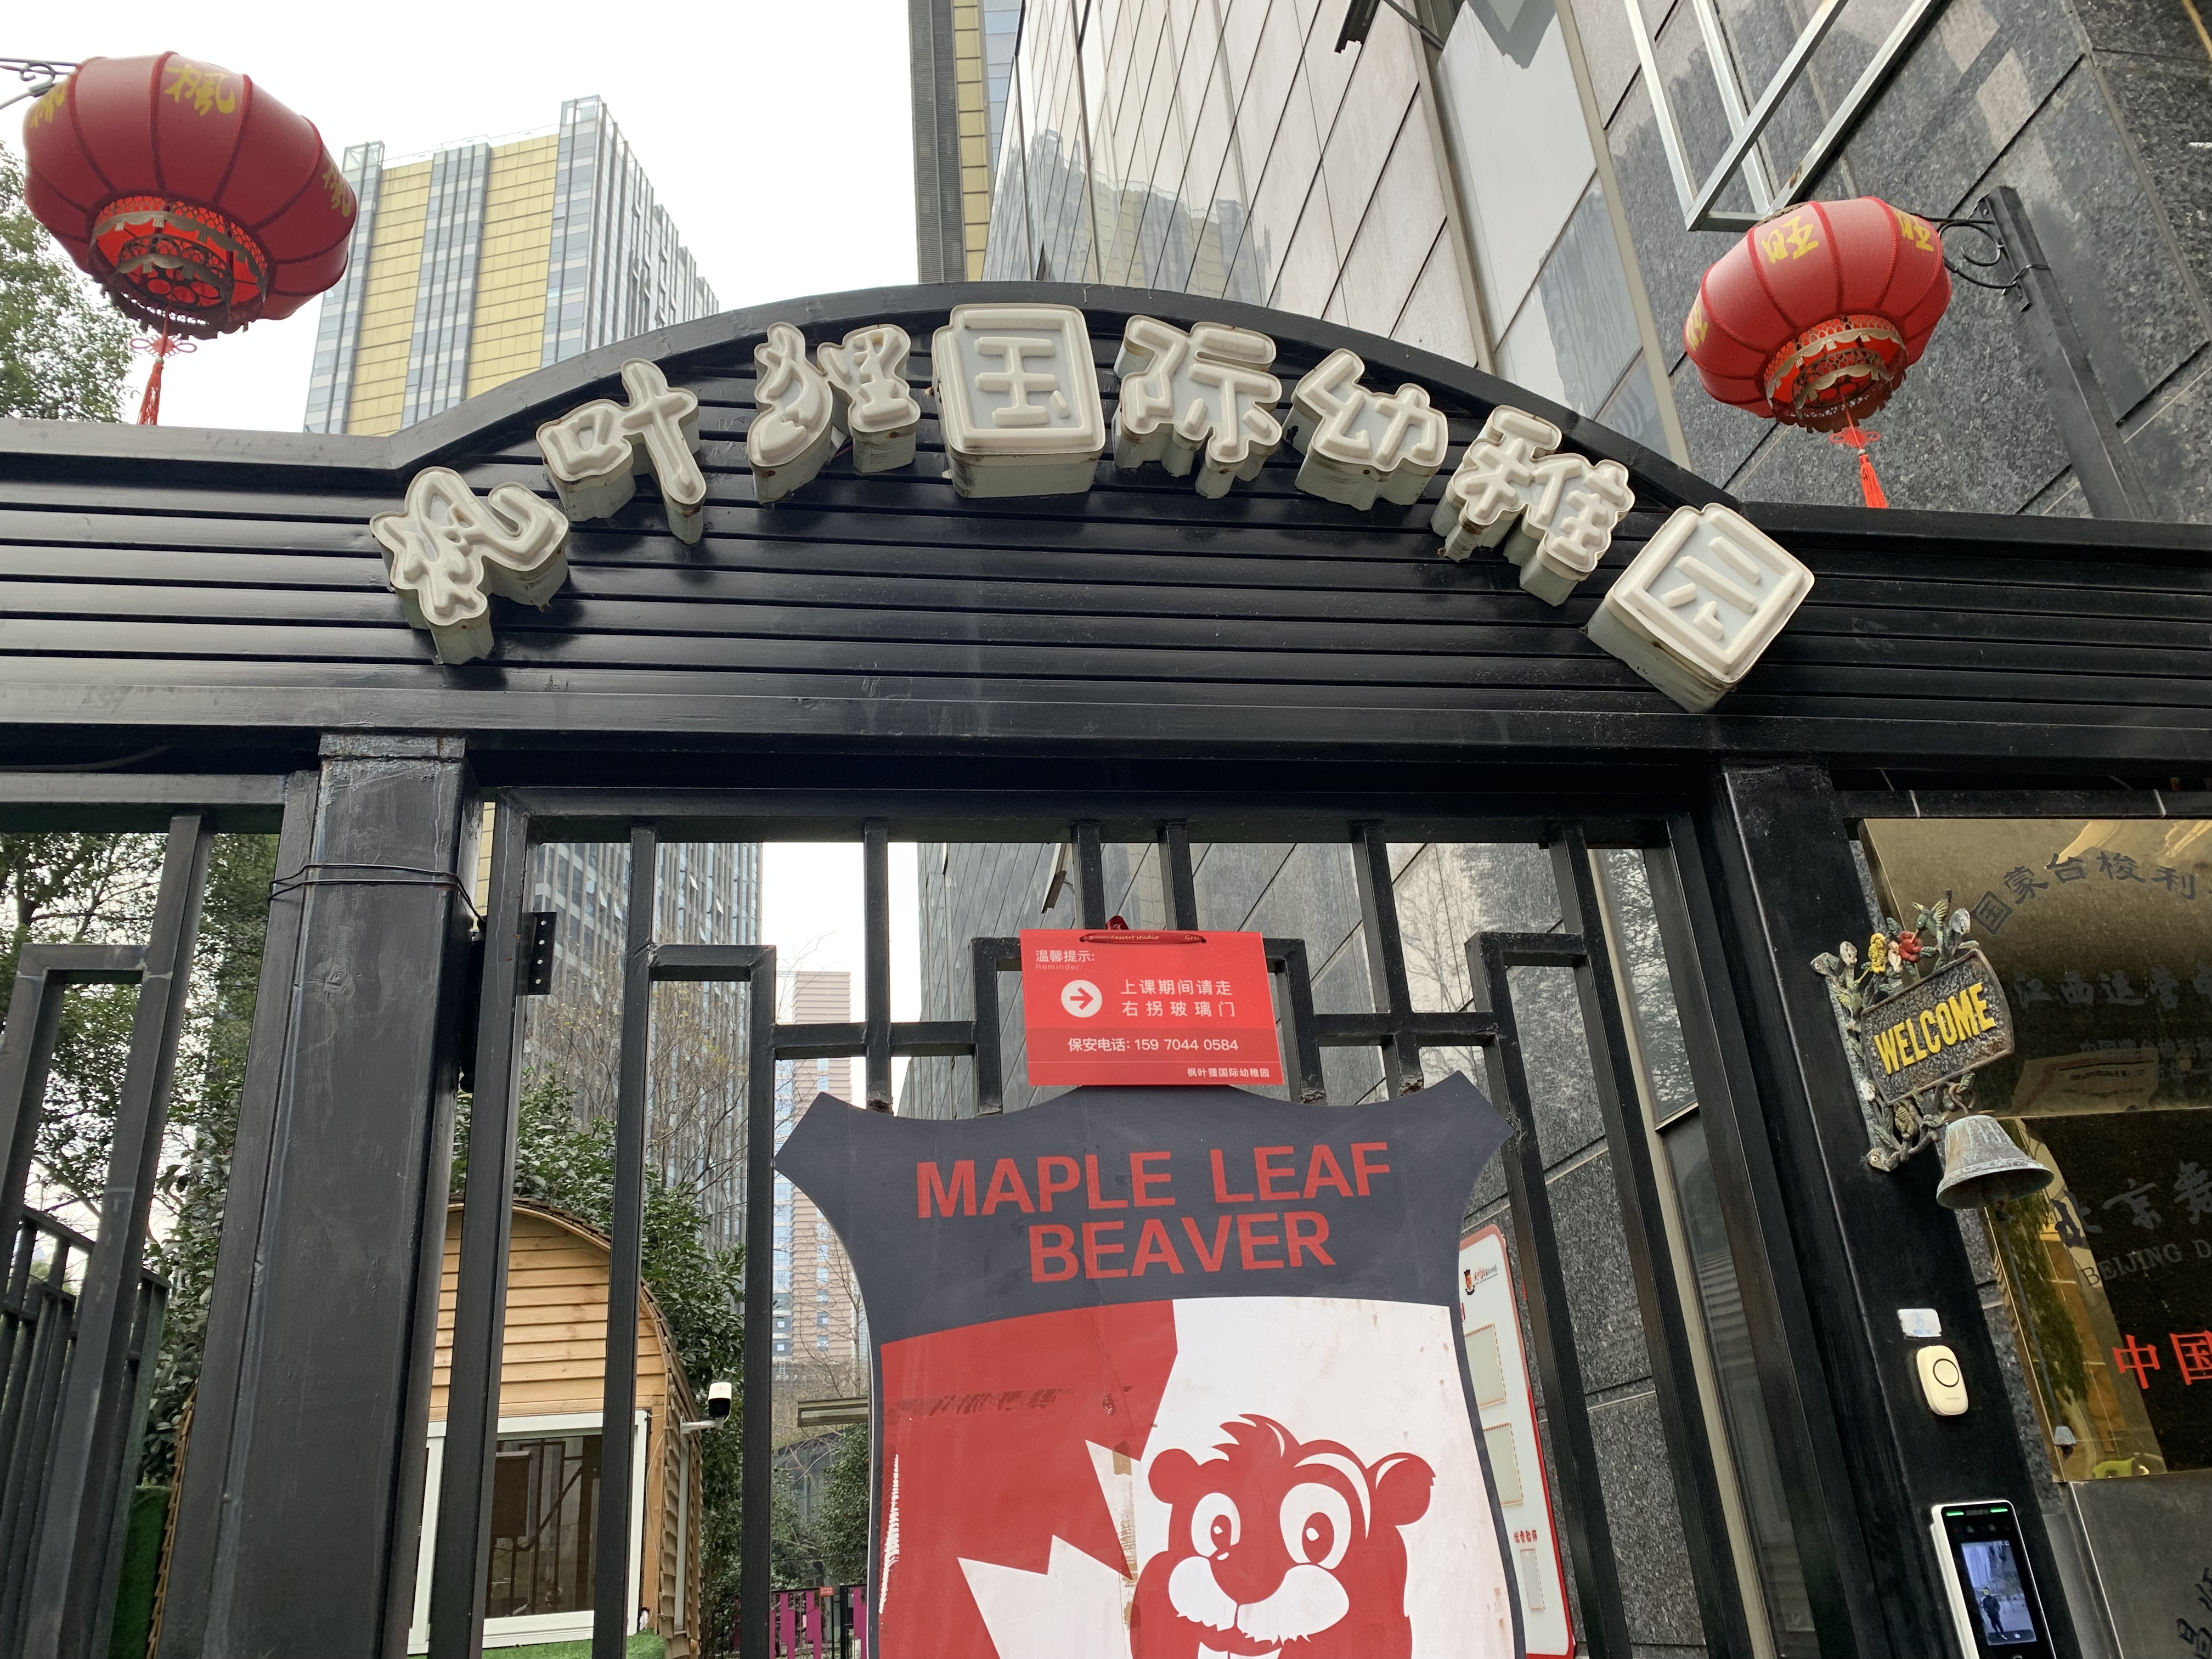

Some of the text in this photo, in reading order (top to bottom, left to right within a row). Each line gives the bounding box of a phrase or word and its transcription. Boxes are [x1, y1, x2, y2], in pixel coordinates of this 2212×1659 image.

[369, 303, 1815, 709] 枫叶狸国际幼稚园
[1970, 850, 2212, 936] 国蒙台梭利
[1035, 950, 1095, 962] 温馨提示:
[1120, 979, 1233, 996] 上课期间请走
[1121, 1001, 1236, 1018] 右拐玻璃门
[1068, 1037, 1239, 1052] 保安电话: 159 7044 0584
[1874, 981, 1996, 1075] WELCOME
[1187, 1068, 1270, 1078] 枫叶狸国际幼稚园
[916, 1141, 1391, 1219] MAPLE LEAF
[1029, 1210, 1337, 1283] BEAVER
[2079, 1243, 2183, 1286] BEIJING
[2112, 1330, 2212, 1390] 中国
